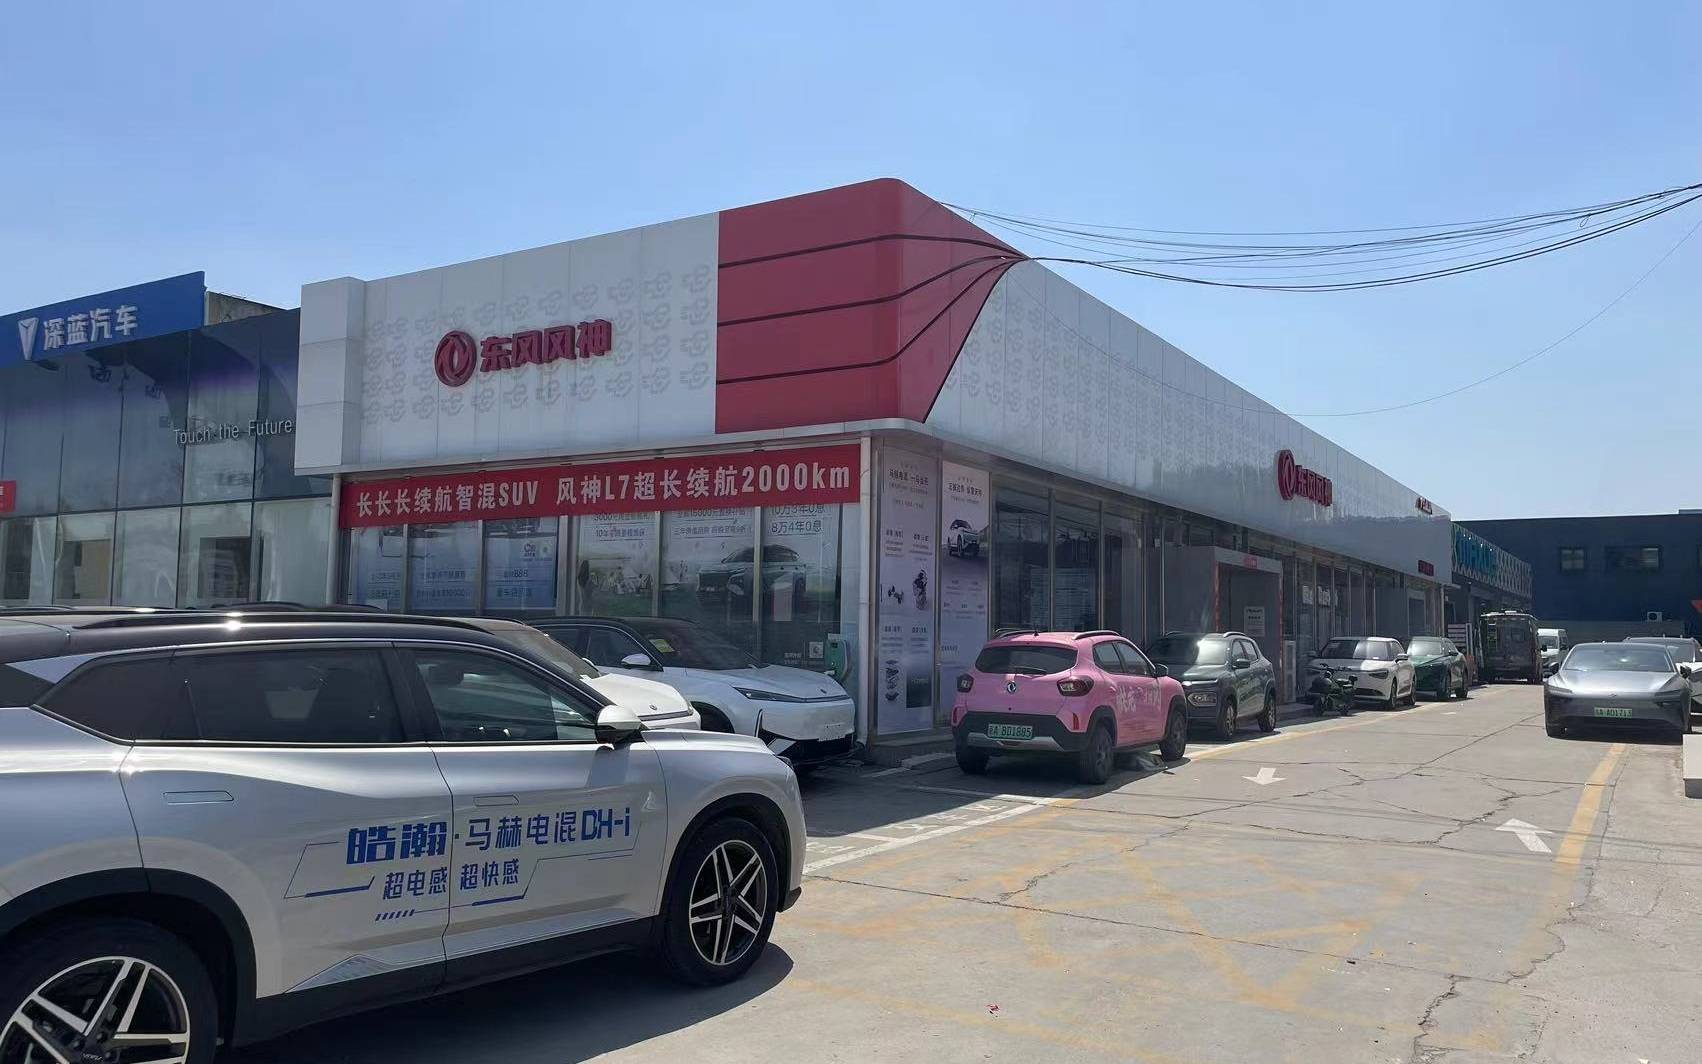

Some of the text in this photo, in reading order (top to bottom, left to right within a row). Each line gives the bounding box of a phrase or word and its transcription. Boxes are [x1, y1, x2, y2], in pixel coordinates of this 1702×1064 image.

[43, 305, 138, 349] 深蓝汽车
[480, 319, 613, 373] 东风风神
[173, 419, 293, 446] Touch the Future
[356, 462, 852, 518] 长长长续航智混SUV 风神L7超长续航2000km
[771, 520, 823, 534] 8万4年0息
[382, 858, 520, 900] 超电感 超快感
